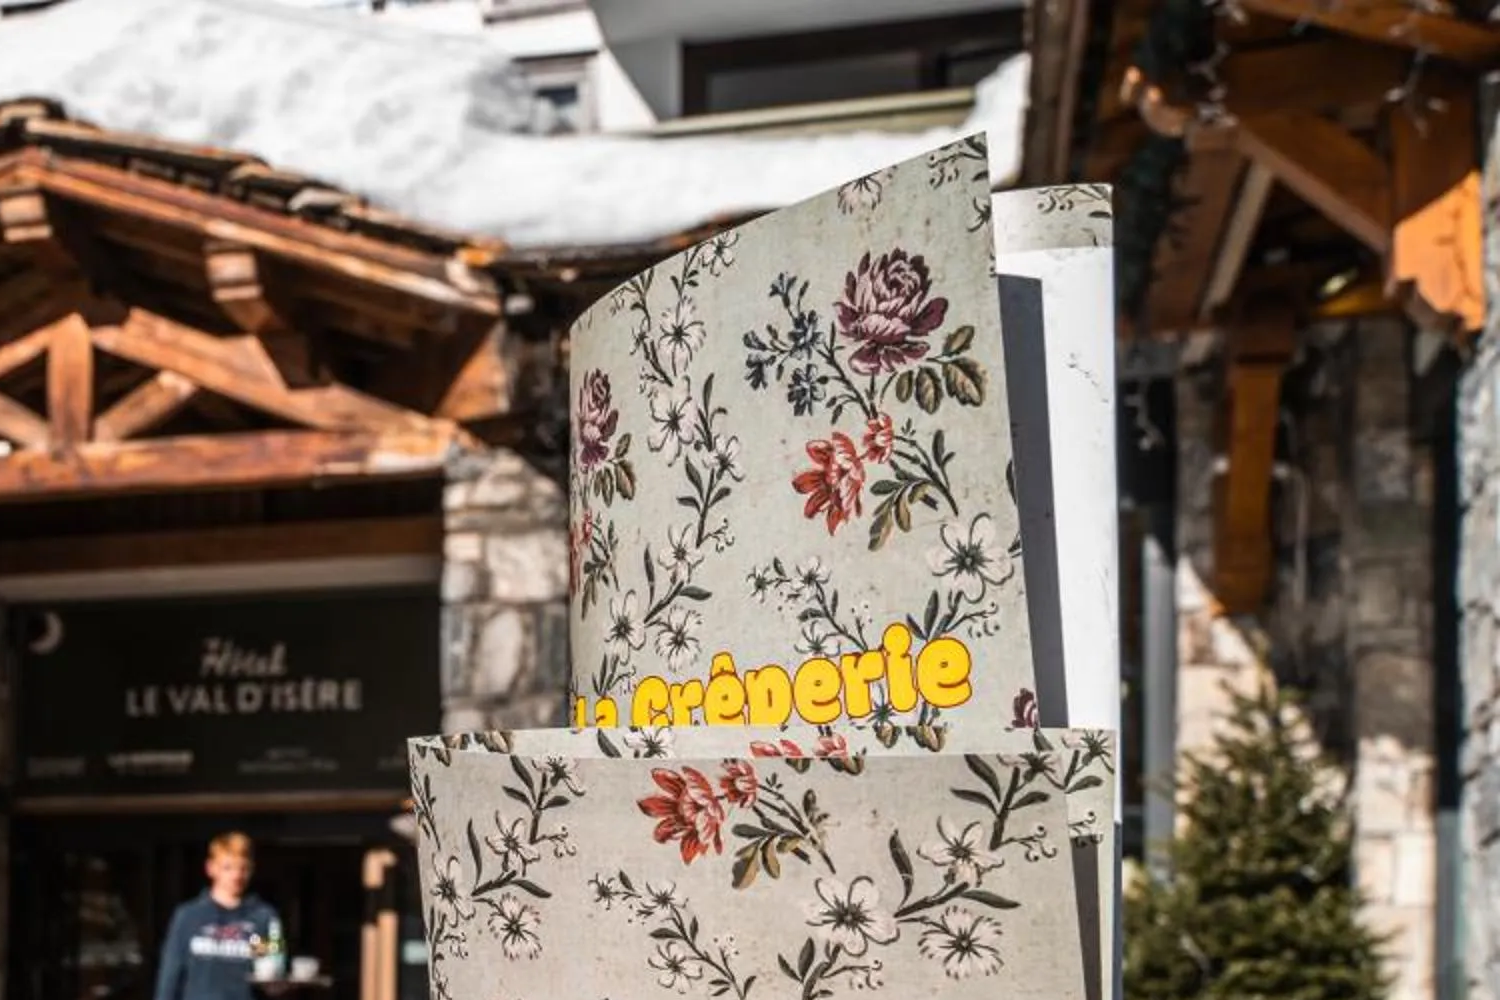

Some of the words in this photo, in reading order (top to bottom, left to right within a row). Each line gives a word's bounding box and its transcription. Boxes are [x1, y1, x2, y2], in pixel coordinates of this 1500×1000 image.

[125, 685, 160, 717] LE
[164, 682, 232, 716] VAL
[631, 622, 974, 728] Crêperie
